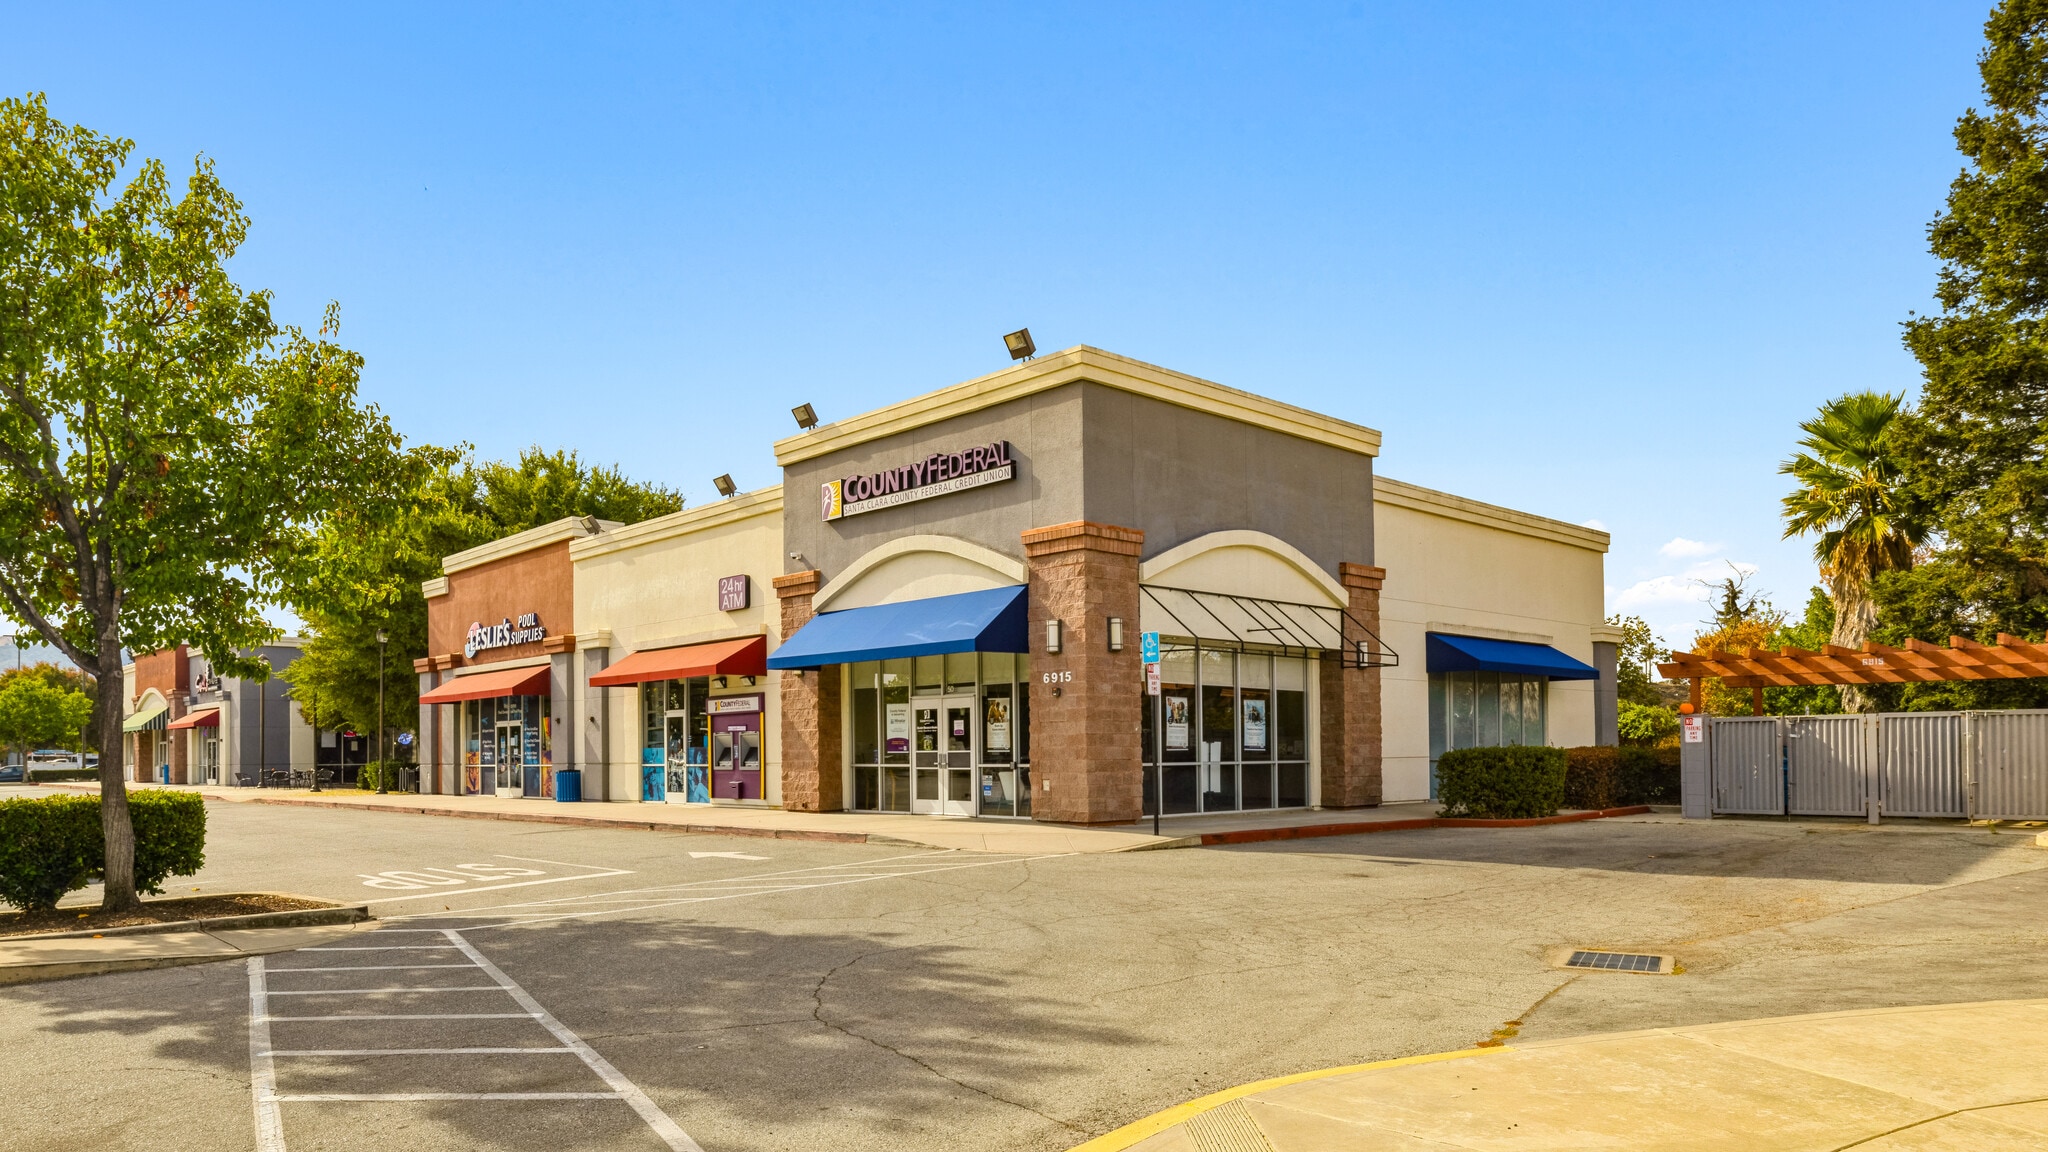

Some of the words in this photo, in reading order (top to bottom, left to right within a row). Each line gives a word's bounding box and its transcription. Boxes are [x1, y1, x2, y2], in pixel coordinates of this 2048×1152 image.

[844, 502, 865, 515] SANTA
[866, 497, 888, 510] CLARA
[890, 489, 919, 504] COUNTY
[921, 483, 952, 497] FEDERAL
[954, 475, 981, 489] CREDIT
[983, 467, 1010, 482] UNION
[722, 592, 743, 609] ATM
[518, 613, 536, 628] POOL
[470, 618, 511, 651] LESLIE'S
[510, 626, 543, 645] SUPPLIES
[1043, 671, 1072, 684] 6915
[356, 863, 547, 890] STOP
